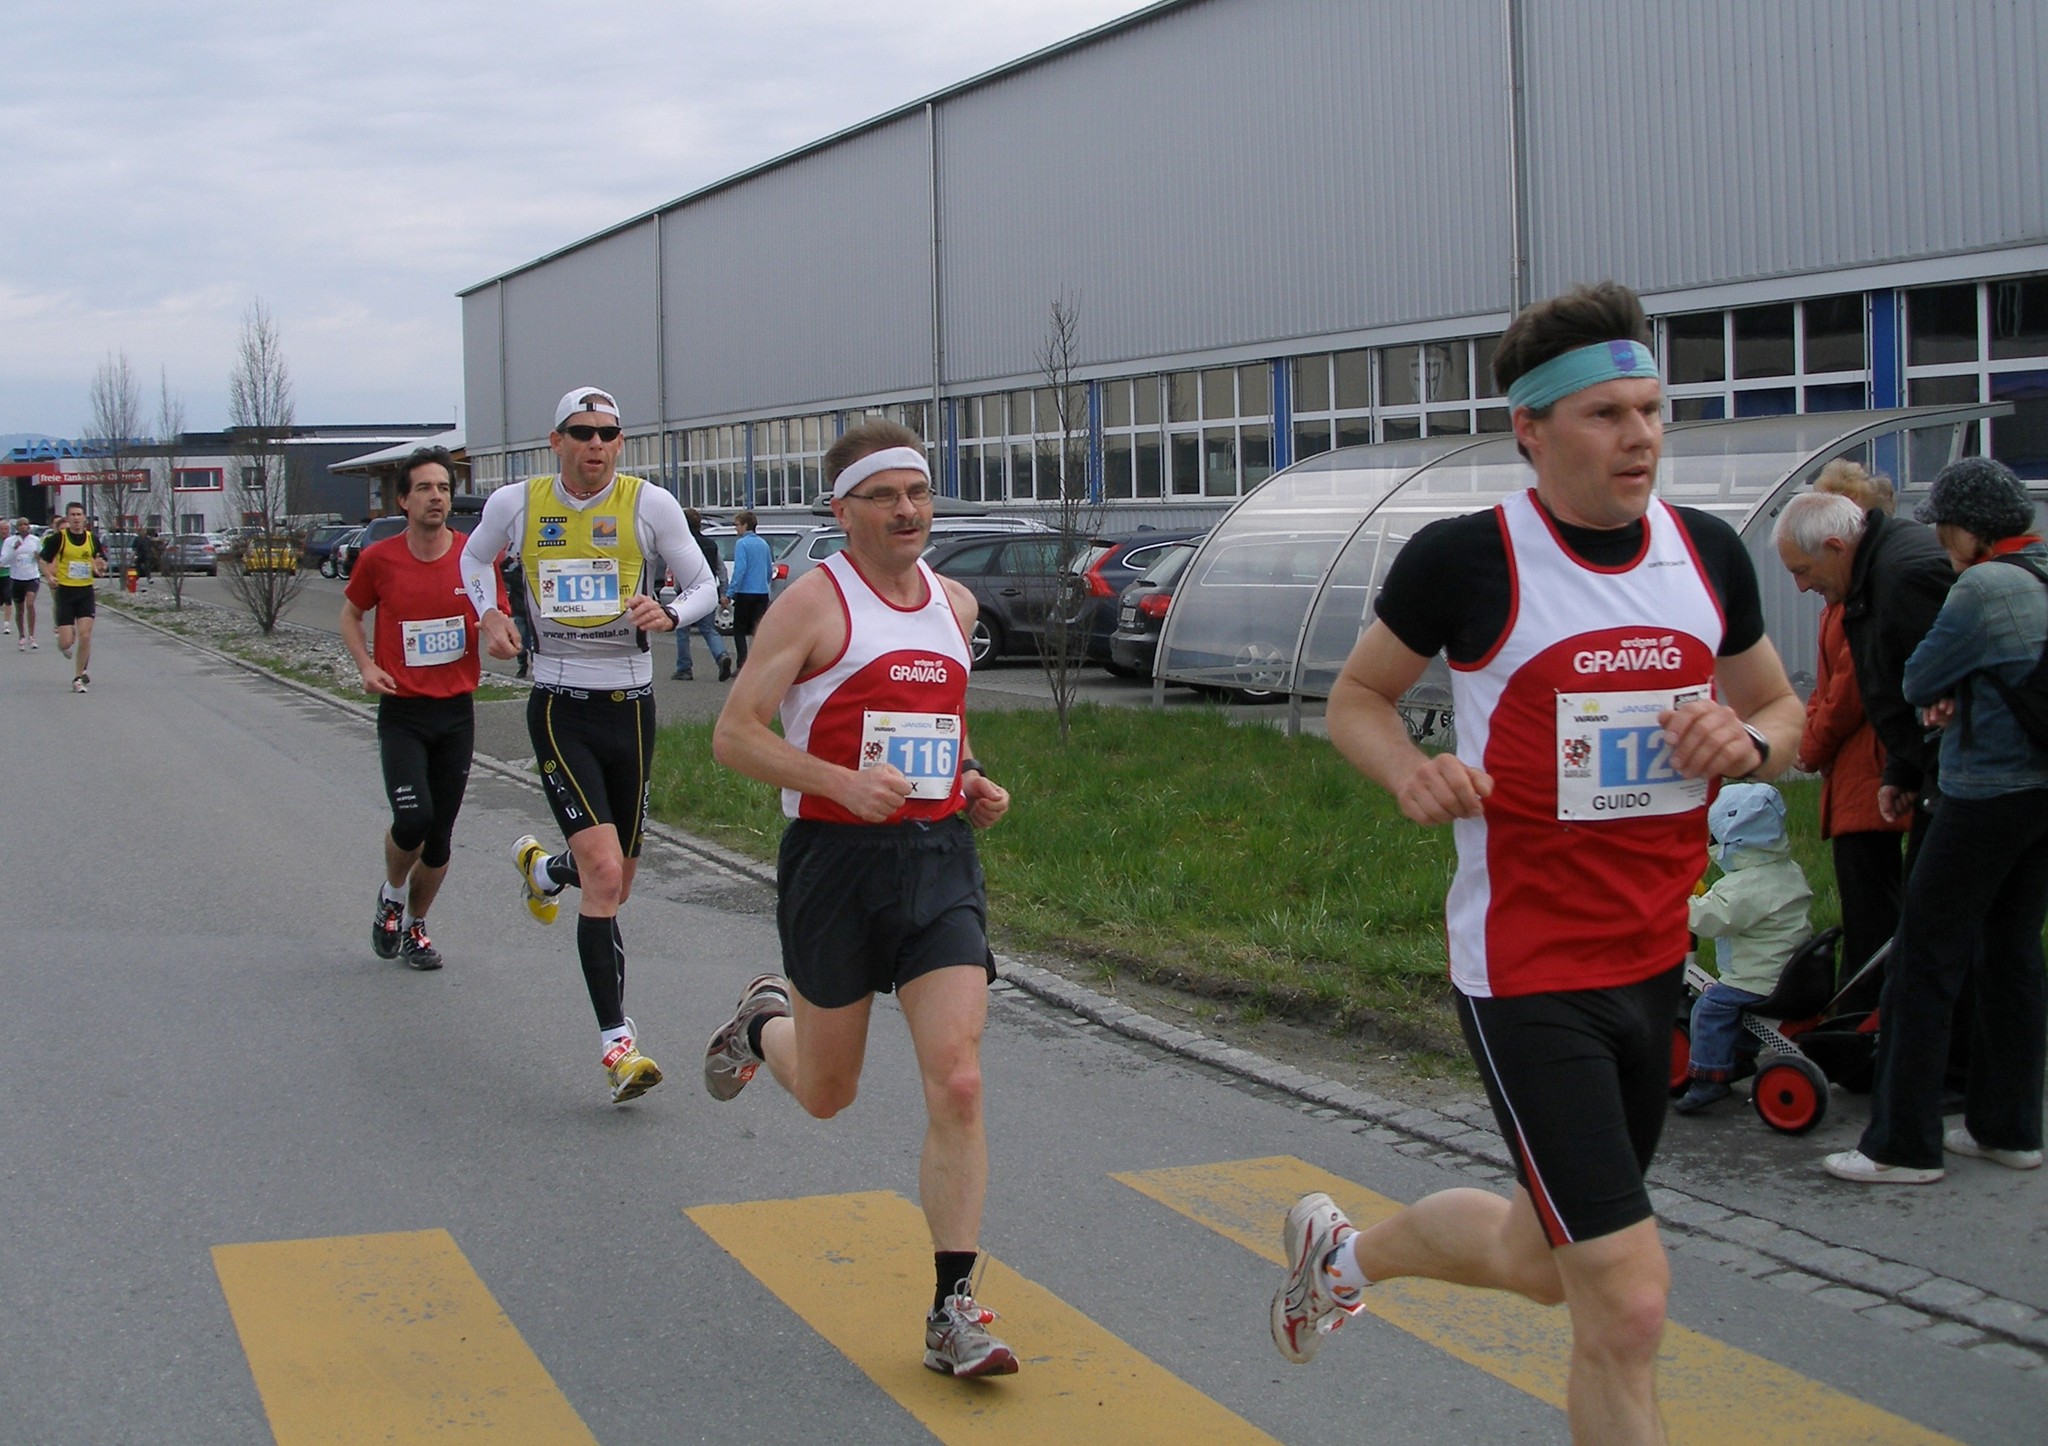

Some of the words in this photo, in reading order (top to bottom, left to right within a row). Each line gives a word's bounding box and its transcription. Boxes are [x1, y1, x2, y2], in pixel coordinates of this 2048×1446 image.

[8, 438, 156, 460] JANS
[40, 473, 62, 482] freie
[63, 473, 105, 482] Tanktee
[566, 576, 606, 600] 191
[553, 605, 587, 613] MICHEL
[425, 631, 459, 652] 888
[1572, 646, 1682, 674] GRAVAG
[890, 665, 947, 683] GRAVAG
[900, 740, 952, 775] 116
[1616, 731, 1671, 782] 12
[1592, 792, 1651, 810] GUIDO
